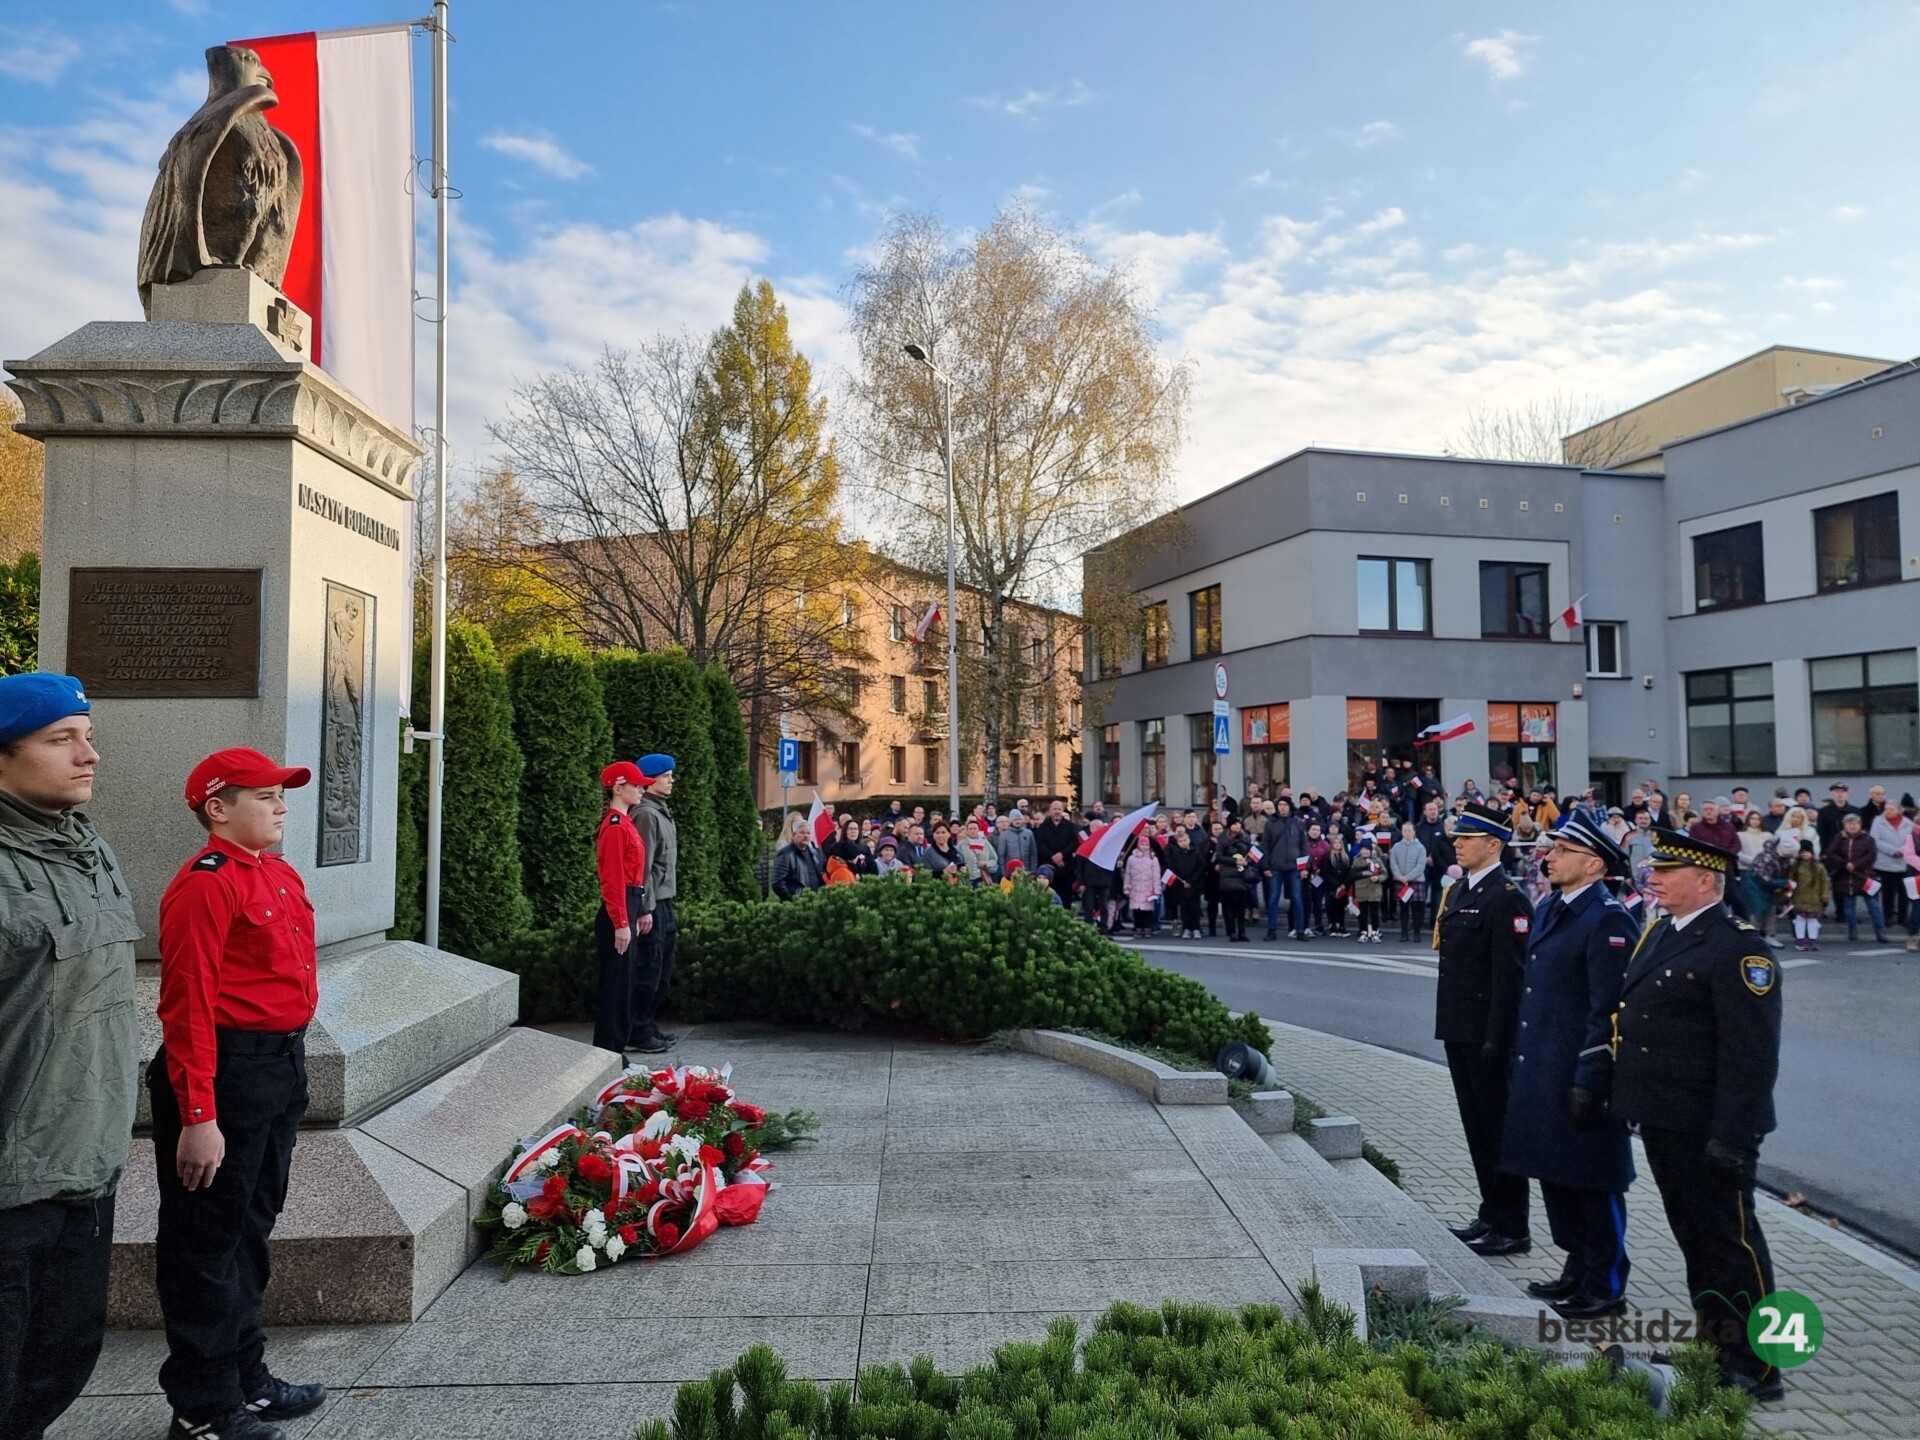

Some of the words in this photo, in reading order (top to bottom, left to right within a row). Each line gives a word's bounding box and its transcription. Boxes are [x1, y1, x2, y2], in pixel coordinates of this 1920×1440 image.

[298, 483, 345, 525] NASZYM
[89, 582, 131, 593] NIECH
[154, 625, 230, 636] PRZYPOMNI
[142, 647, 206, 657] PROCHOM
[783, 742, 794, 767] P
